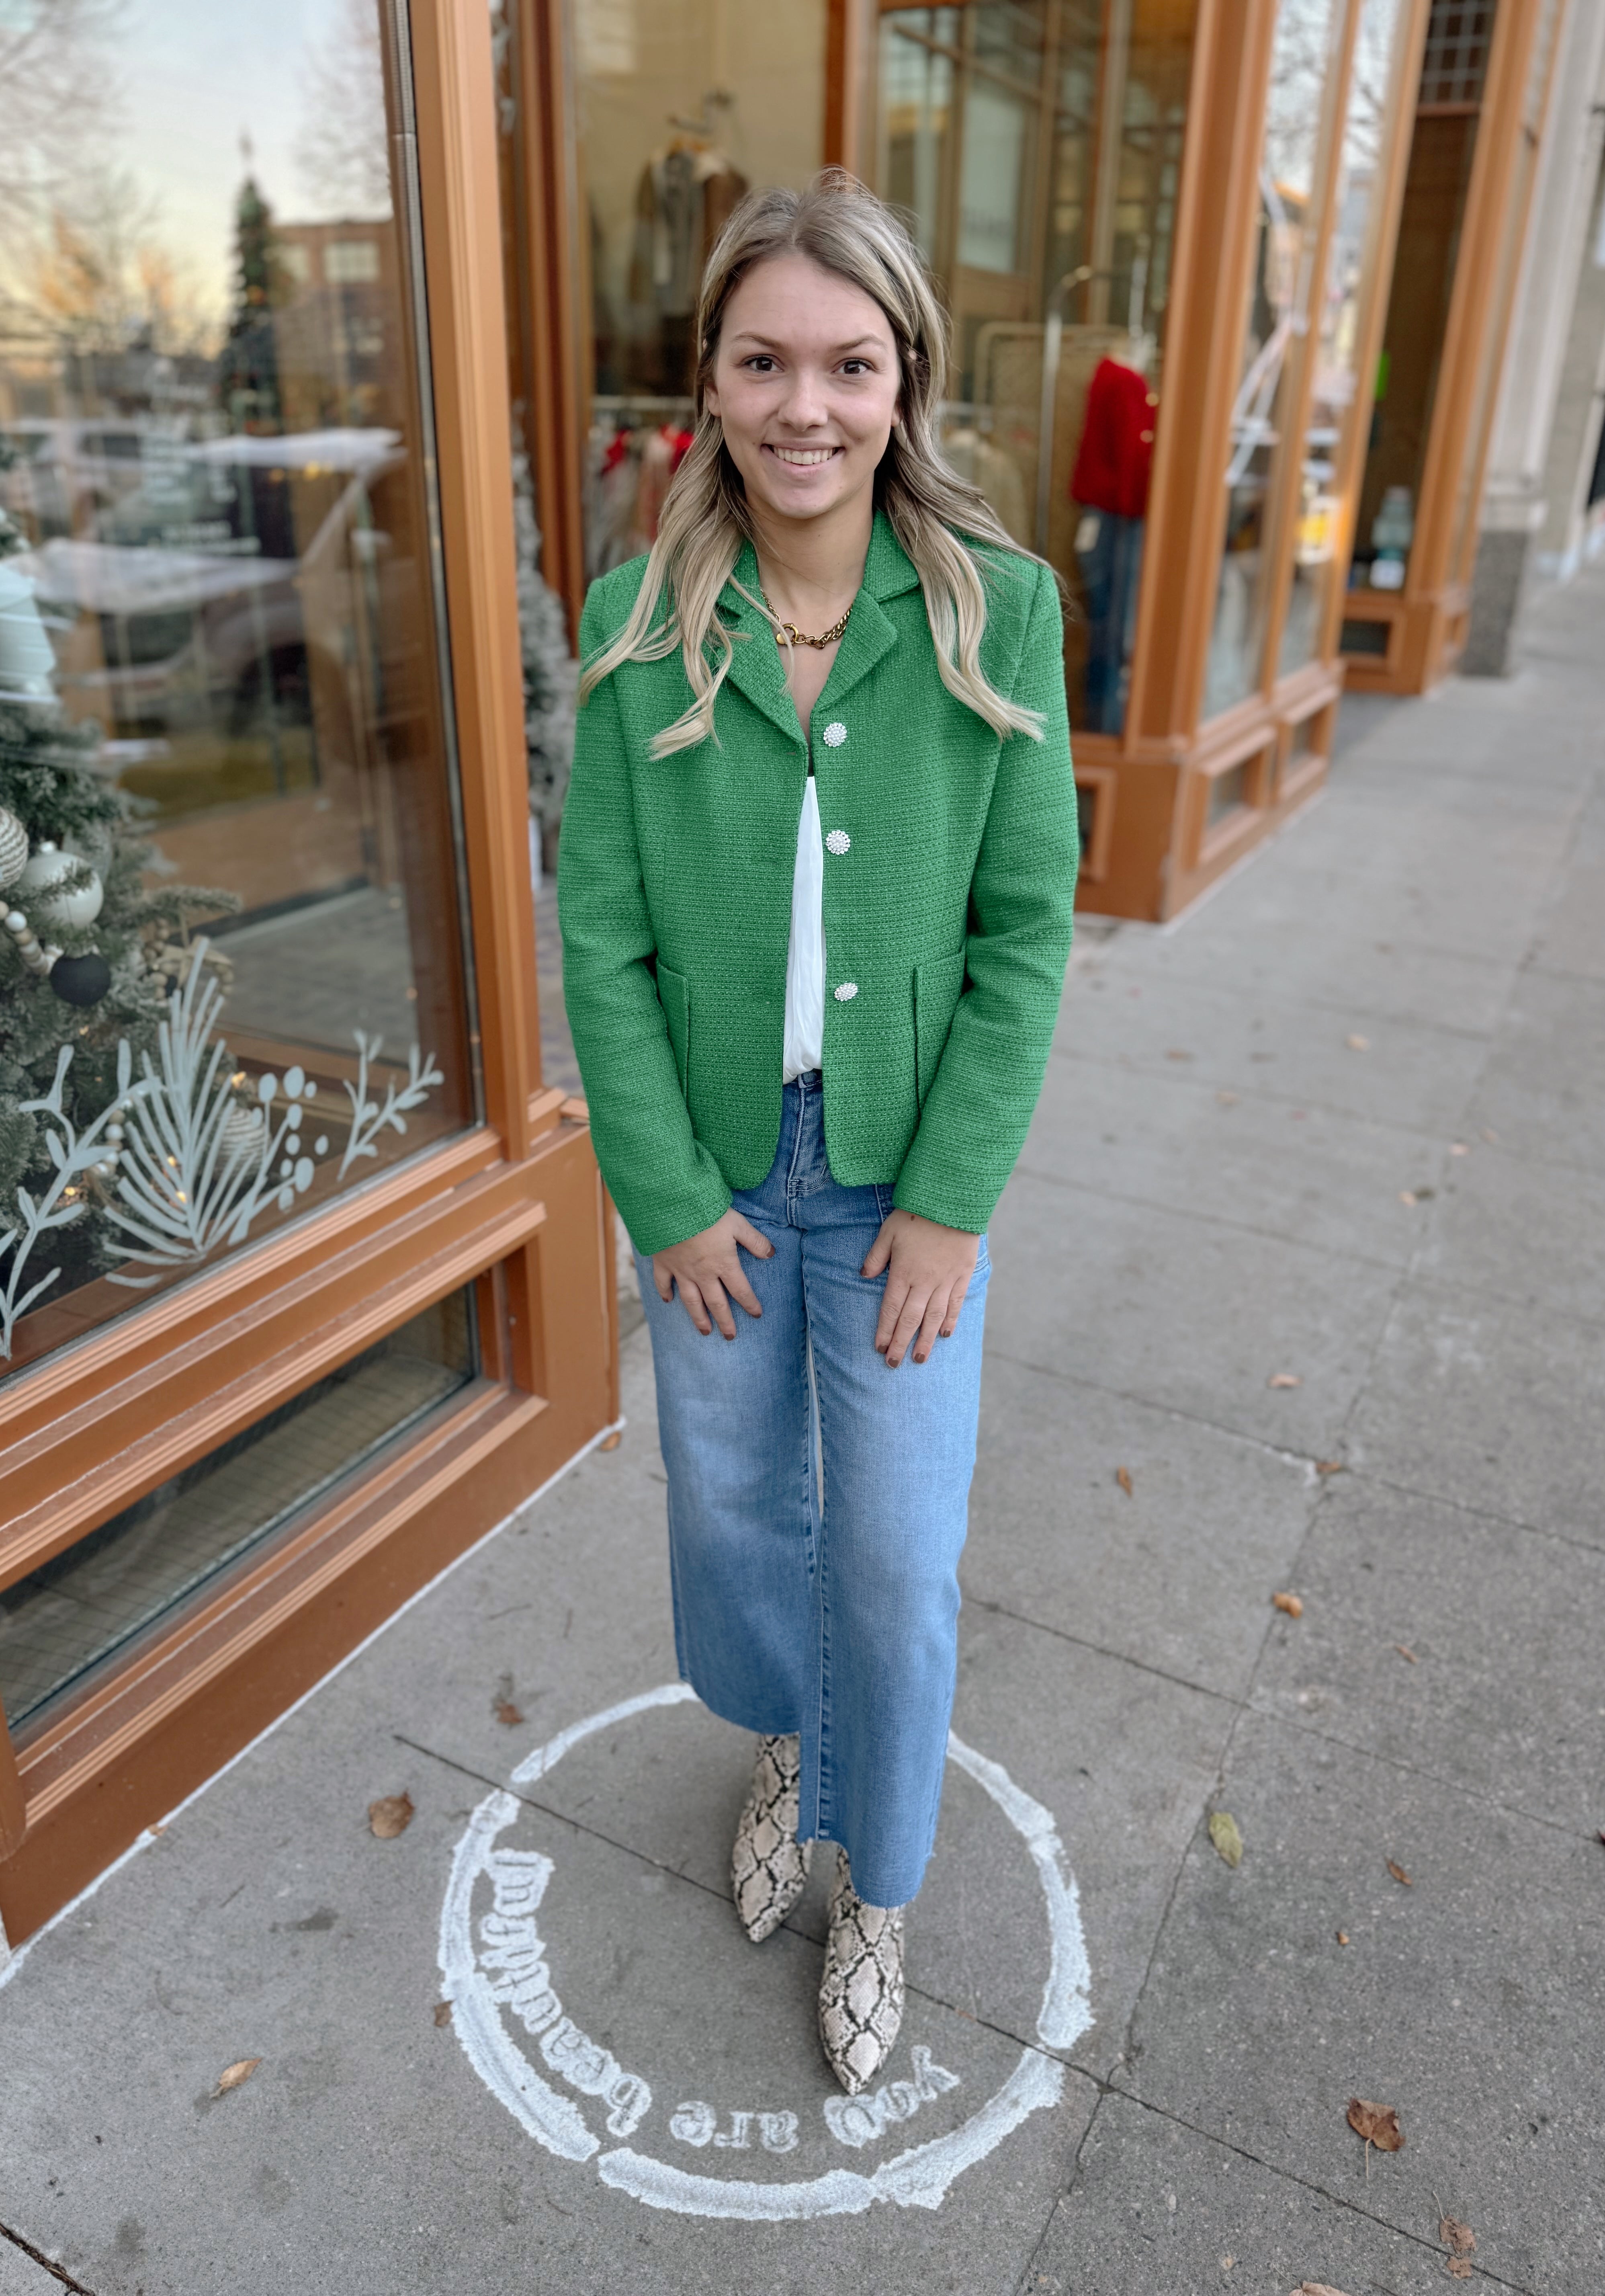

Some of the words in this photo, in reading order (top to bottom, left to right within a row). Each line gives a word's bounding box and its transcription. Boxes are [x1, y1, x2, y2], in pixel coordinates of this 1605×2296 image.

[479, 1847, 652, 2137] beautiful
[669, 2100, 799, 2153] are
[823, 2045, 960, 2148] you
